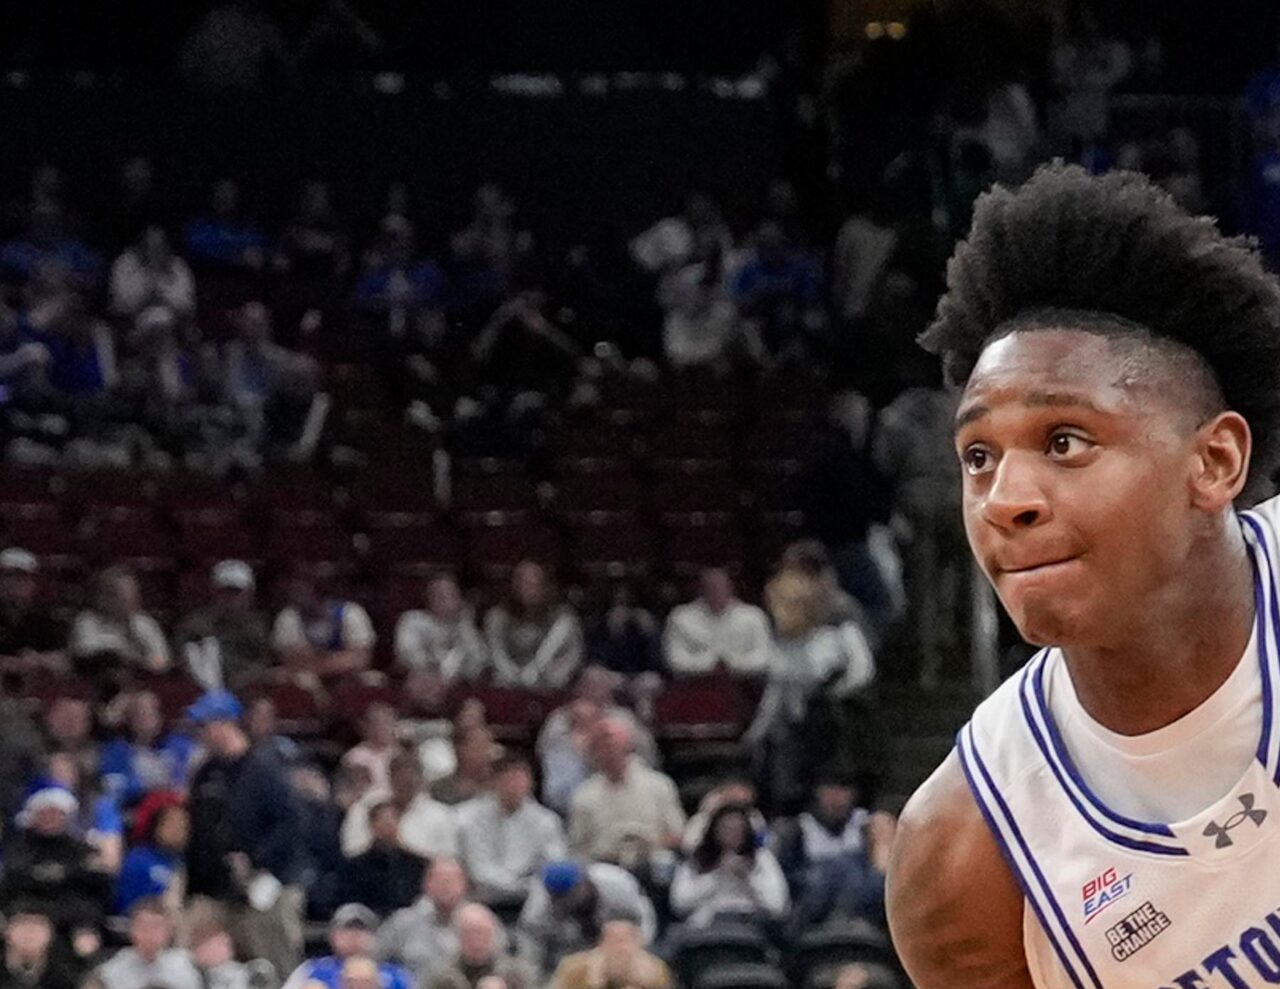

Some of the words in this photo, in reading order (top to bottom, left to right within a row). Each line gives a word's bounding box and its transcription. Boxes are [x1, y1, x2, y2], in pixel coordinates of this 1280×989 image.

[1082, 867, 1117, 900] BIG
[1084, 873, 1133, 916] EAST
[1106, 922, 1131, 946] BE
[1127, 902, 1157, 931] THE
[1112, 912, 1171, 961] CHANGE
